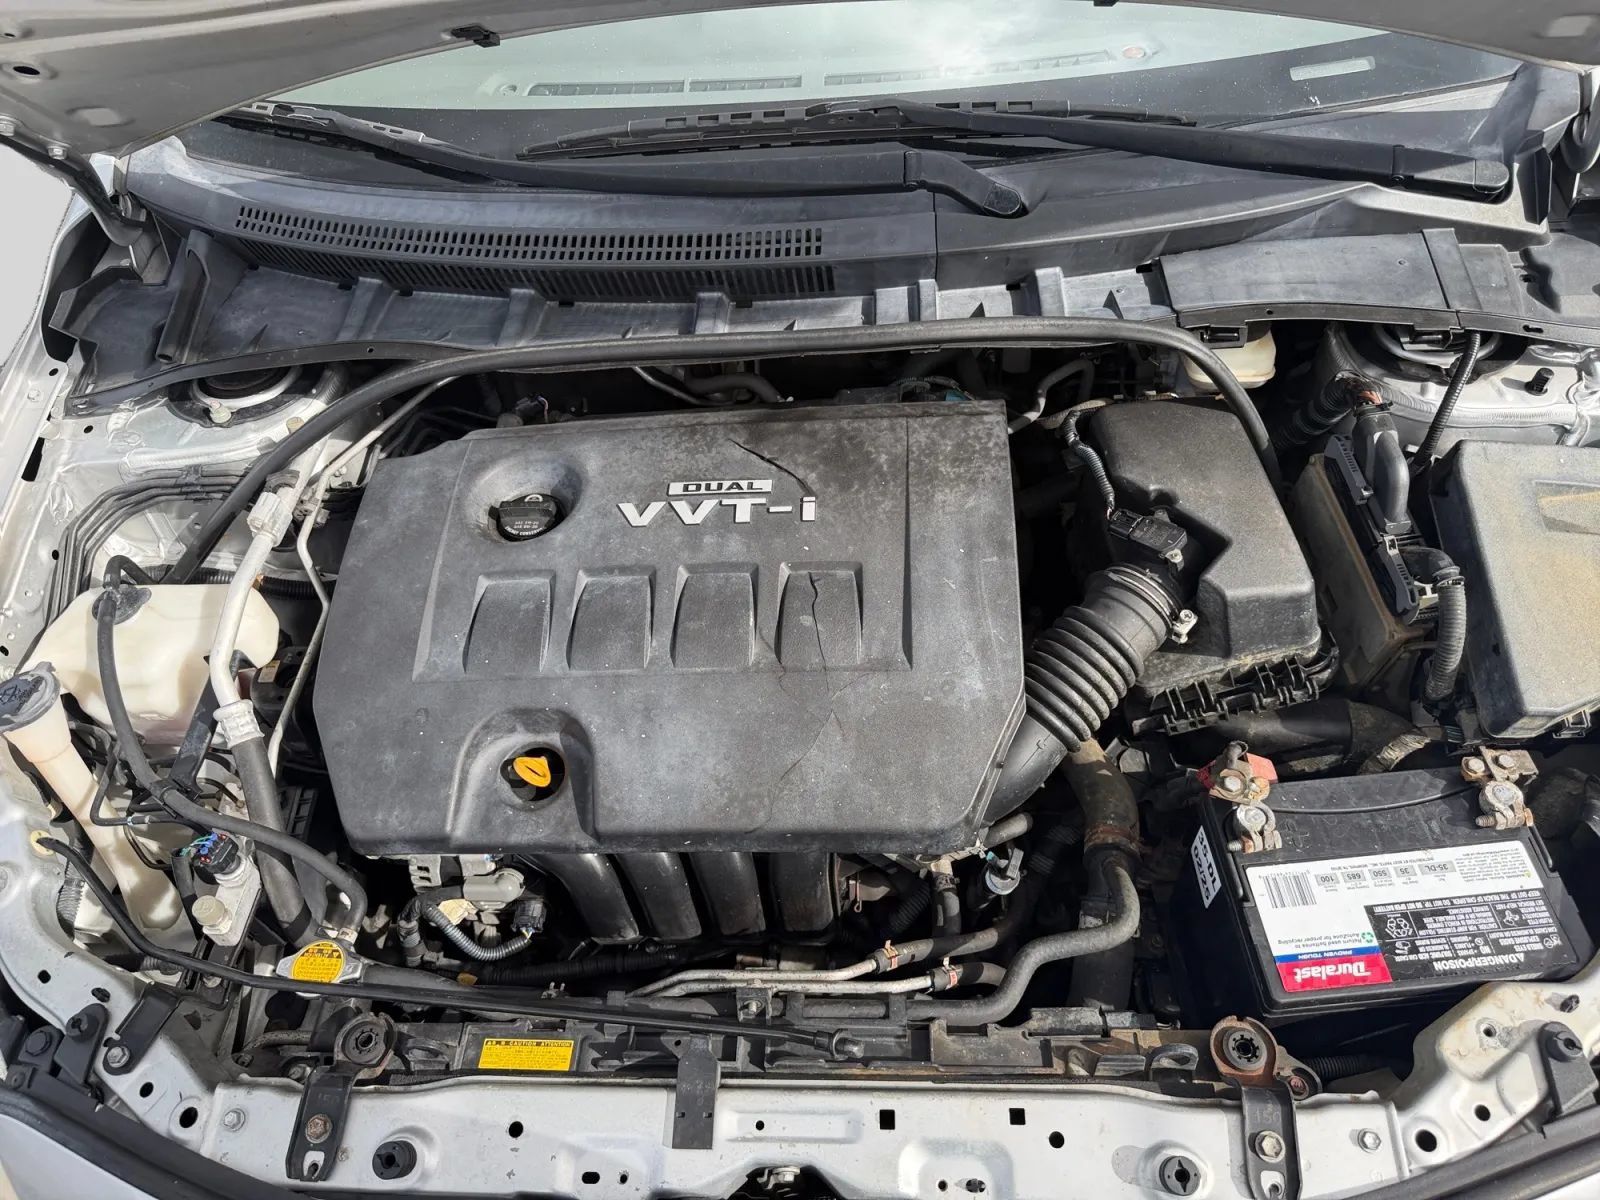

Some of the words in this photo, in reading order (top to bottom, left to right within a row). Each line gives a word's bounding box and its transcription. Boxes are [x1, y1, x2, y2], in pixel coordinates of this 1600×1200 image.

[682, 482, 763, 492] DUAL
[616, 496, 816, 527] VVT-i
[1479, 945, 1490, 953] NO
[1434, 954, 1516, 969] DANGER/POISON
[1295, 962, 1369, 981] Duralast
